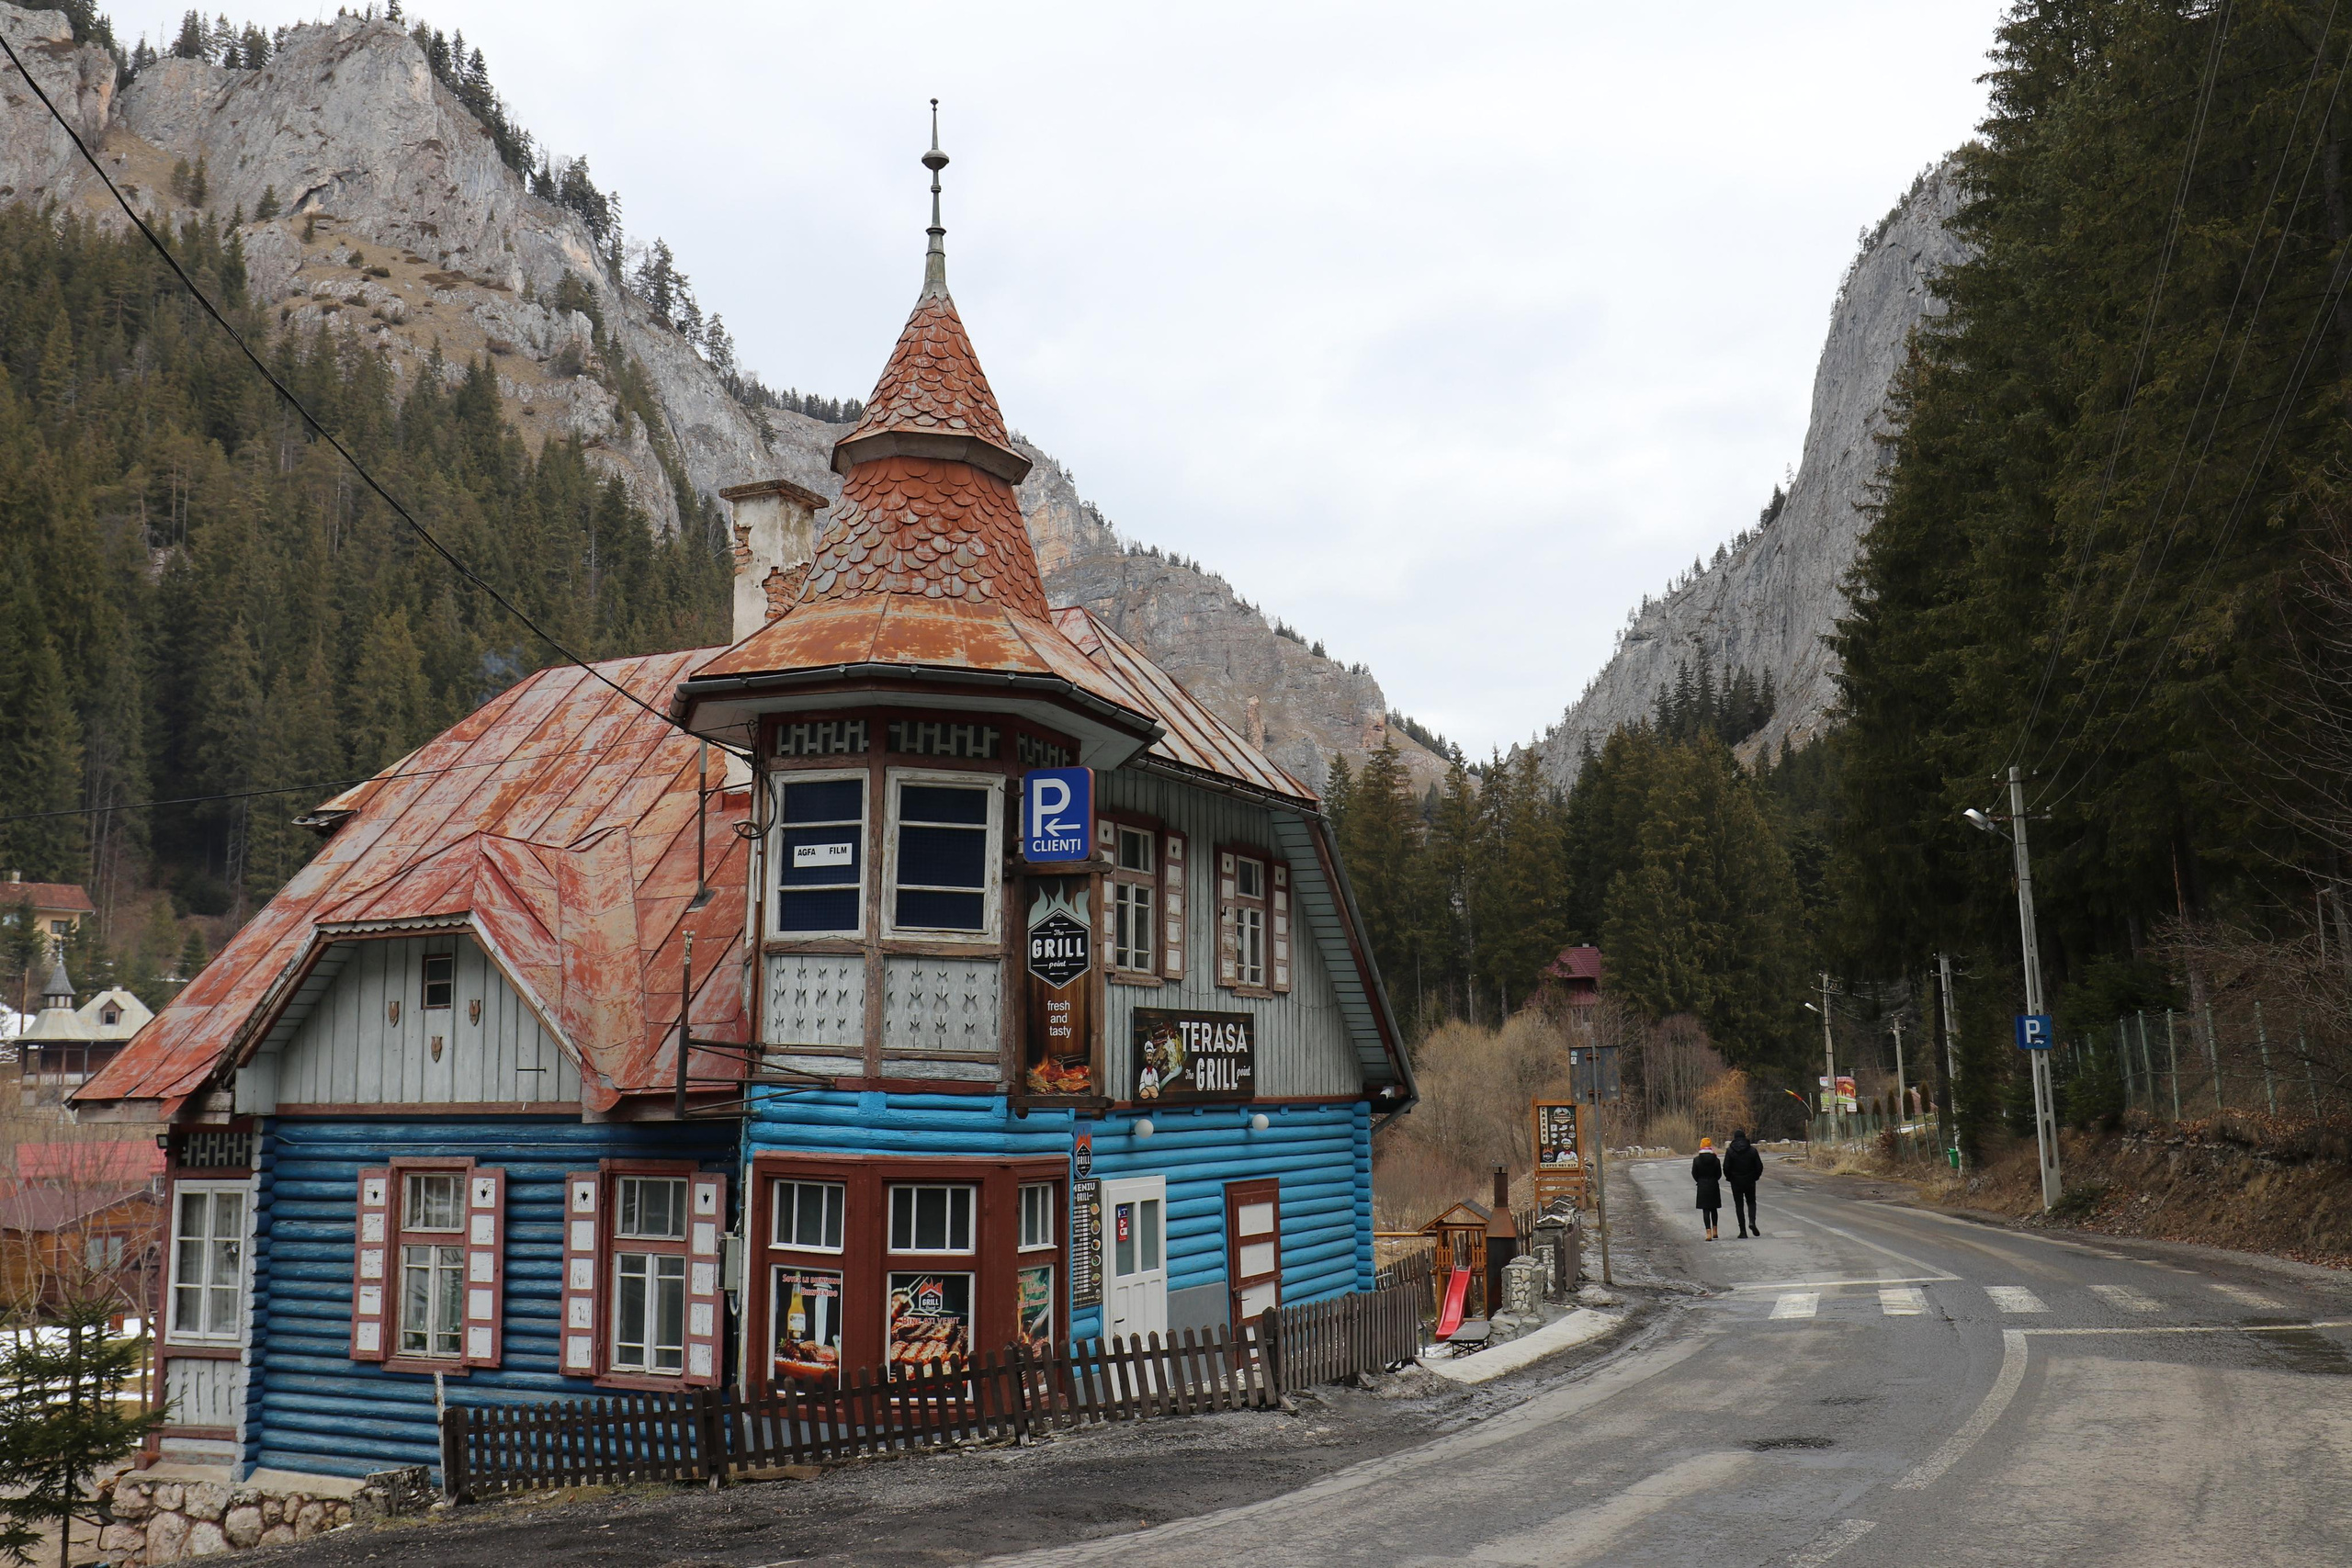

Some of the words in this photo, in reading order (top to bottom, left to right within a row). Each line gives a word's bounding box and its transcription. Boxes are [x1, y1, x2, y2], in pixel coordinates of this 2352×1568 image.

[1033, 778, 1071, 838] P
[797, 848, 816, 856] AGFA
[829, 846, 847, 854] FILM
[1033, 839, 1081, 854] CLIENȚI
[1031, 938, 1085, 959] GRILL
[1048, 960, 1067, 969] point
[1047, 999, 1070, 1011] fresh
[1050, 1012, 1068, 1023] and
[1049, 1025, 1071, 1038] tasty
[1179, 1021, 1248, 1053] TERASA
[2025, 1019, 2041, 1043] P
[1185, 1068, 1194, 1080] The
[1196, 1057, 1238, 1091] GRILL
[1237, 1066, 1250, 1080] point
[1077, 1155, 1091, 1166] GRILL
[922, 1298, 939, 1306] GRILL
[936, 1316, 960, 1325] VENIT
